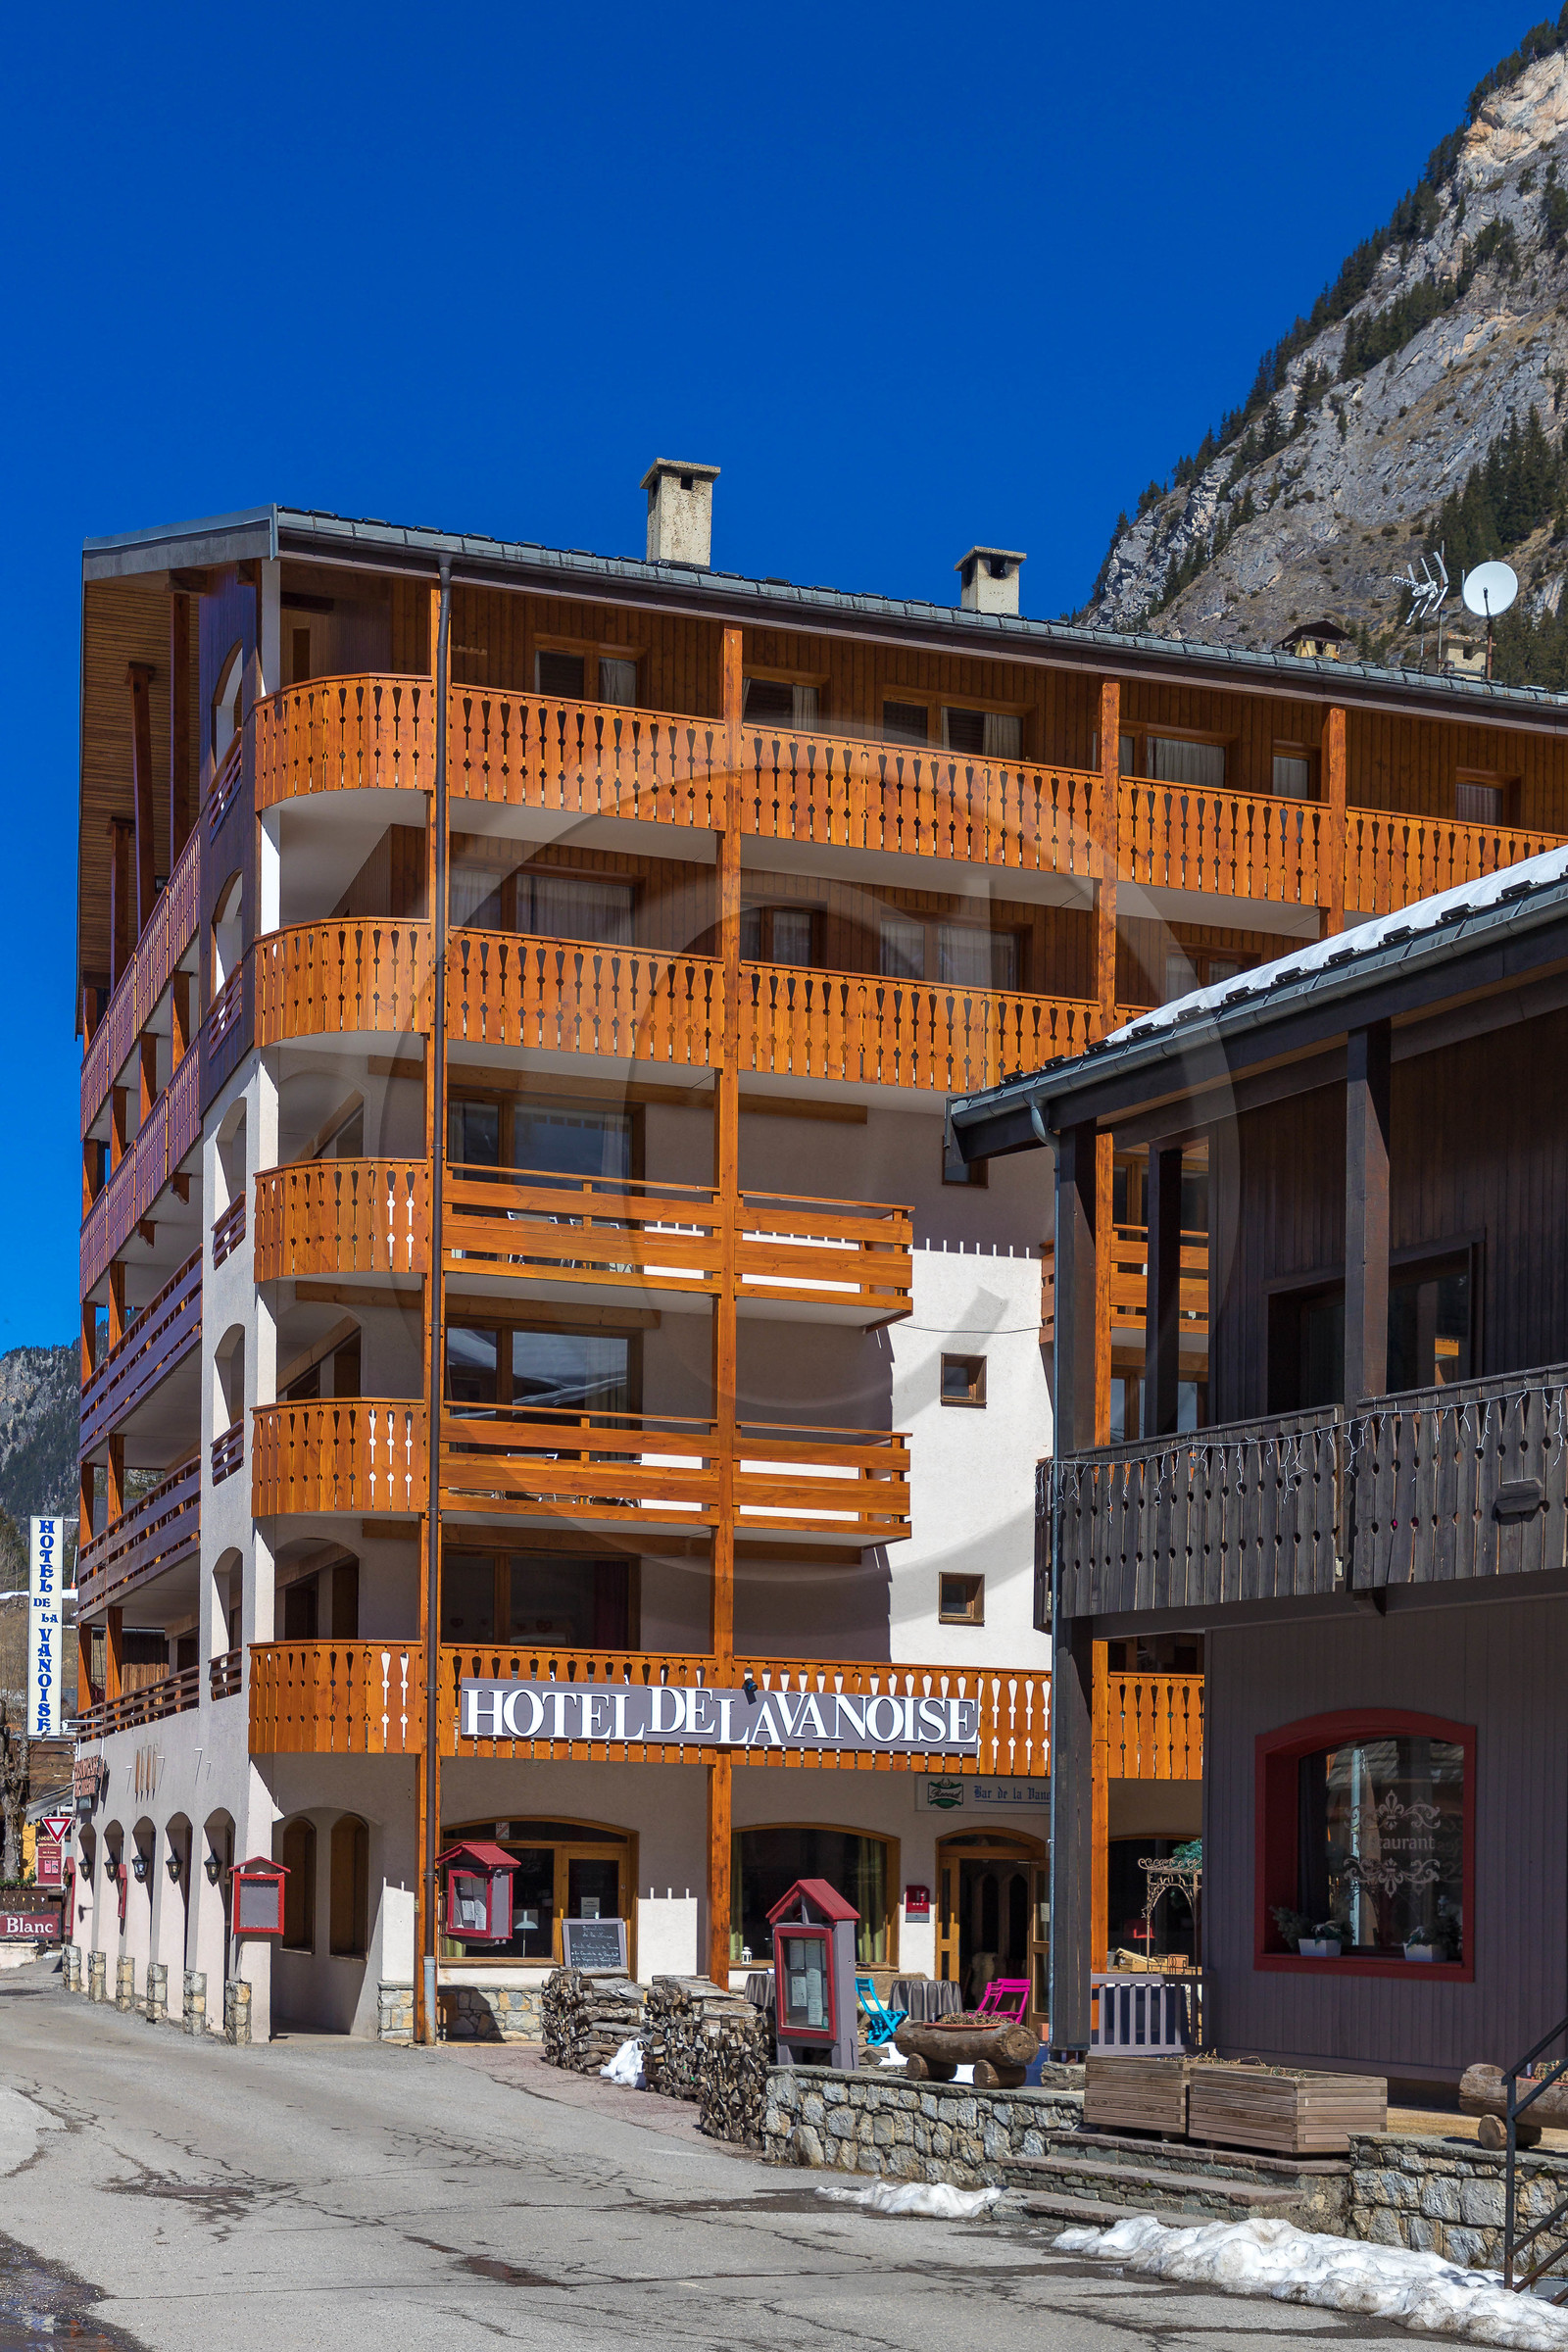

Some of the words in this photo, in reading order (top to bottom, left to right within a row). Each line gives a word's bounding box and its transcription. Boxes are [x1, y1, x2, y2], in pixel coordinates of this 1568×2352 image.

[39, 1519, 55, 1592] HOTEL
[33, 1597, 51, 1608] DE
[41, 1612, 59, 1624] LA
[36, 1628, 53, 1734] VANOISE
[463, 1689, 645, 1740] HOTEL
[646, 1686, 716, 1734] DE
[715, 1698, 785, 1747] LA
[771, 1691, 978, 1744] VANOISE
[974, 1785, 992, 1799] Bar
[998, 1787, 1008, 1799] de
[1013, 1788, 1022, 1800] la
[1351, 1834, 1436, 1850] Rtaurant
[6, 1917, 54, 1934] Blanc
